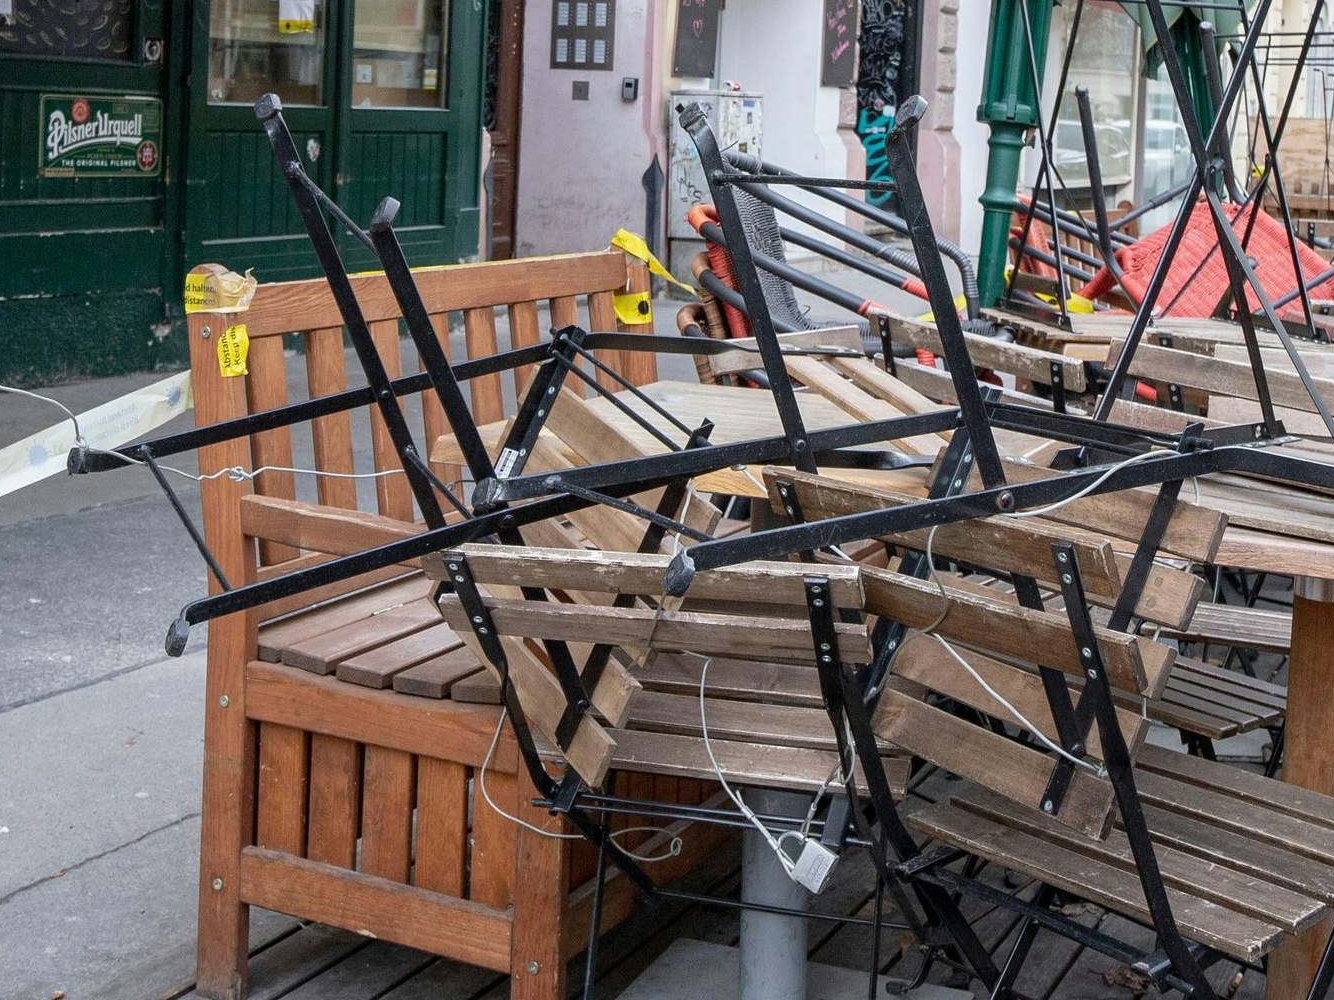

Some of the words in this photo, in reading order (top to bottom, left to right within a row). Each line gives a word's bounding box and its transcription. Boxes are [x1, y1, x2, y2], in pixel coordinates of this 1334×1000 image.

[47, 110, 100, 159] Pilsner
[97, 110, 142, 146] Urquell
[62, 159, 74, 168] THE
